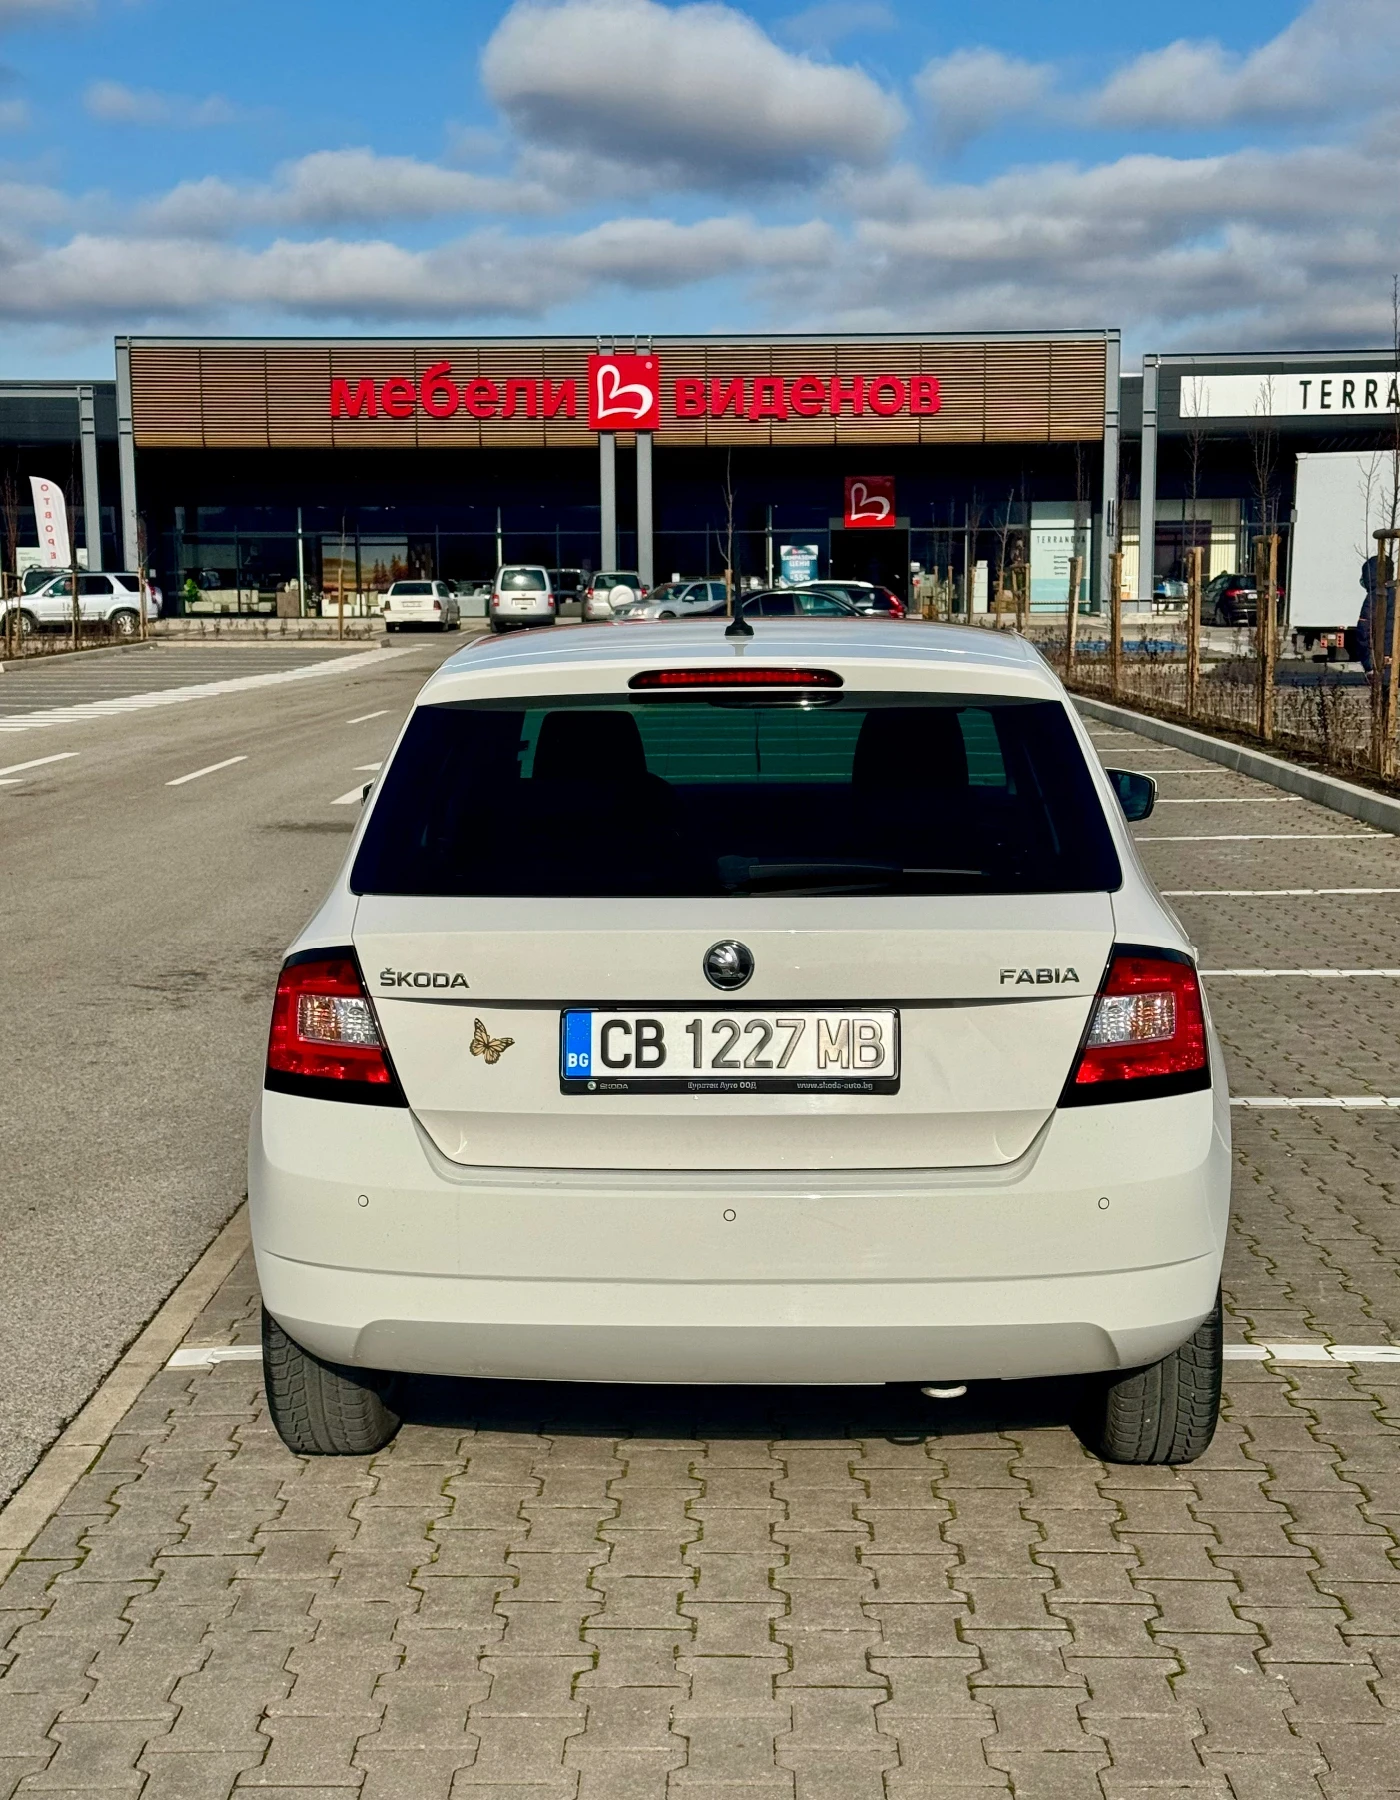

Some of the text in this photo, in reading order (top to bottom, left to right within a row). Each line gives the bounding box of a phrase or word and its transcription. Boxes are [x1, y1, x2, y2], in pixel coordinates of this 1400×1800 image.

[331, 361, 943, 421] мебели виденов
[1299, 378, 1400, 411] TERRA
[1036, 535, 1086, 544] TERRANOVA
[379, 967, 470, 988] ŠKODA
[999, 967, 1080, 985] FABIA
[600, 1018, 886, 1069] CB 1227 MB
[567, 1052, 589, 1068] BG
[719, 1081, 738, 1091] Ауто
[739, 1081, 757, 1090] ООД
[796, 1081, 873, 1091] www.skoda-auto.bg
